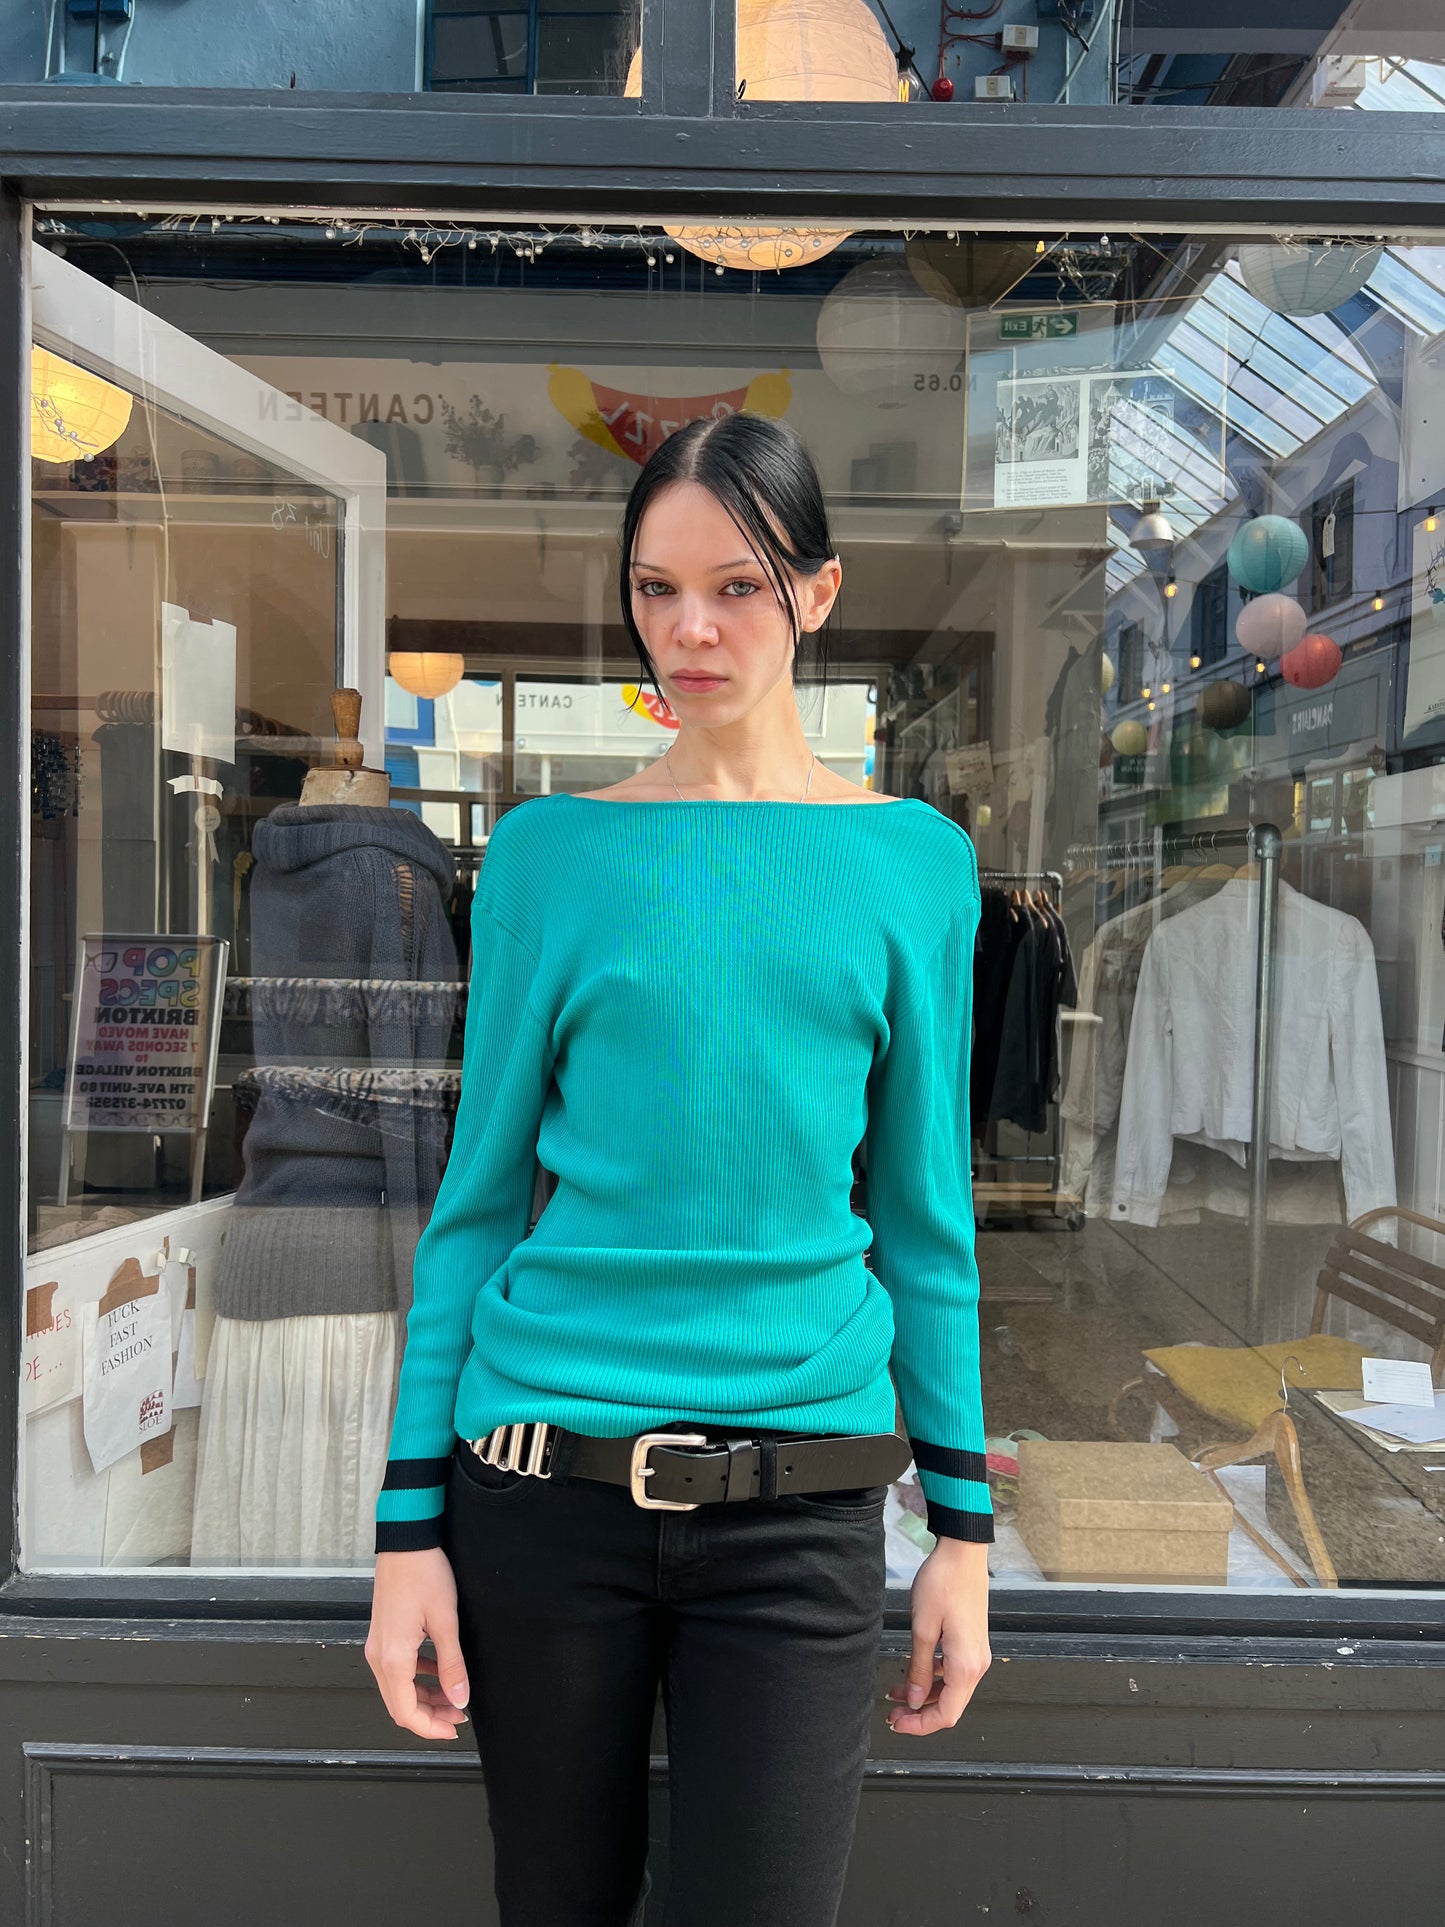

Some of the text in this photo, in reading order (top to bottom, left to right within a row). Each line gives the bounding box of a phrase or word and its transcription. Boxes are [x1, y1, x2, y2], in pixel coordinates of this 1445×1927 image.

[107, 1300, 140, 1328] FUCK
[110, 1321, 138, 1348] FAST
[101, 1335, 153, 1377] FASHION
